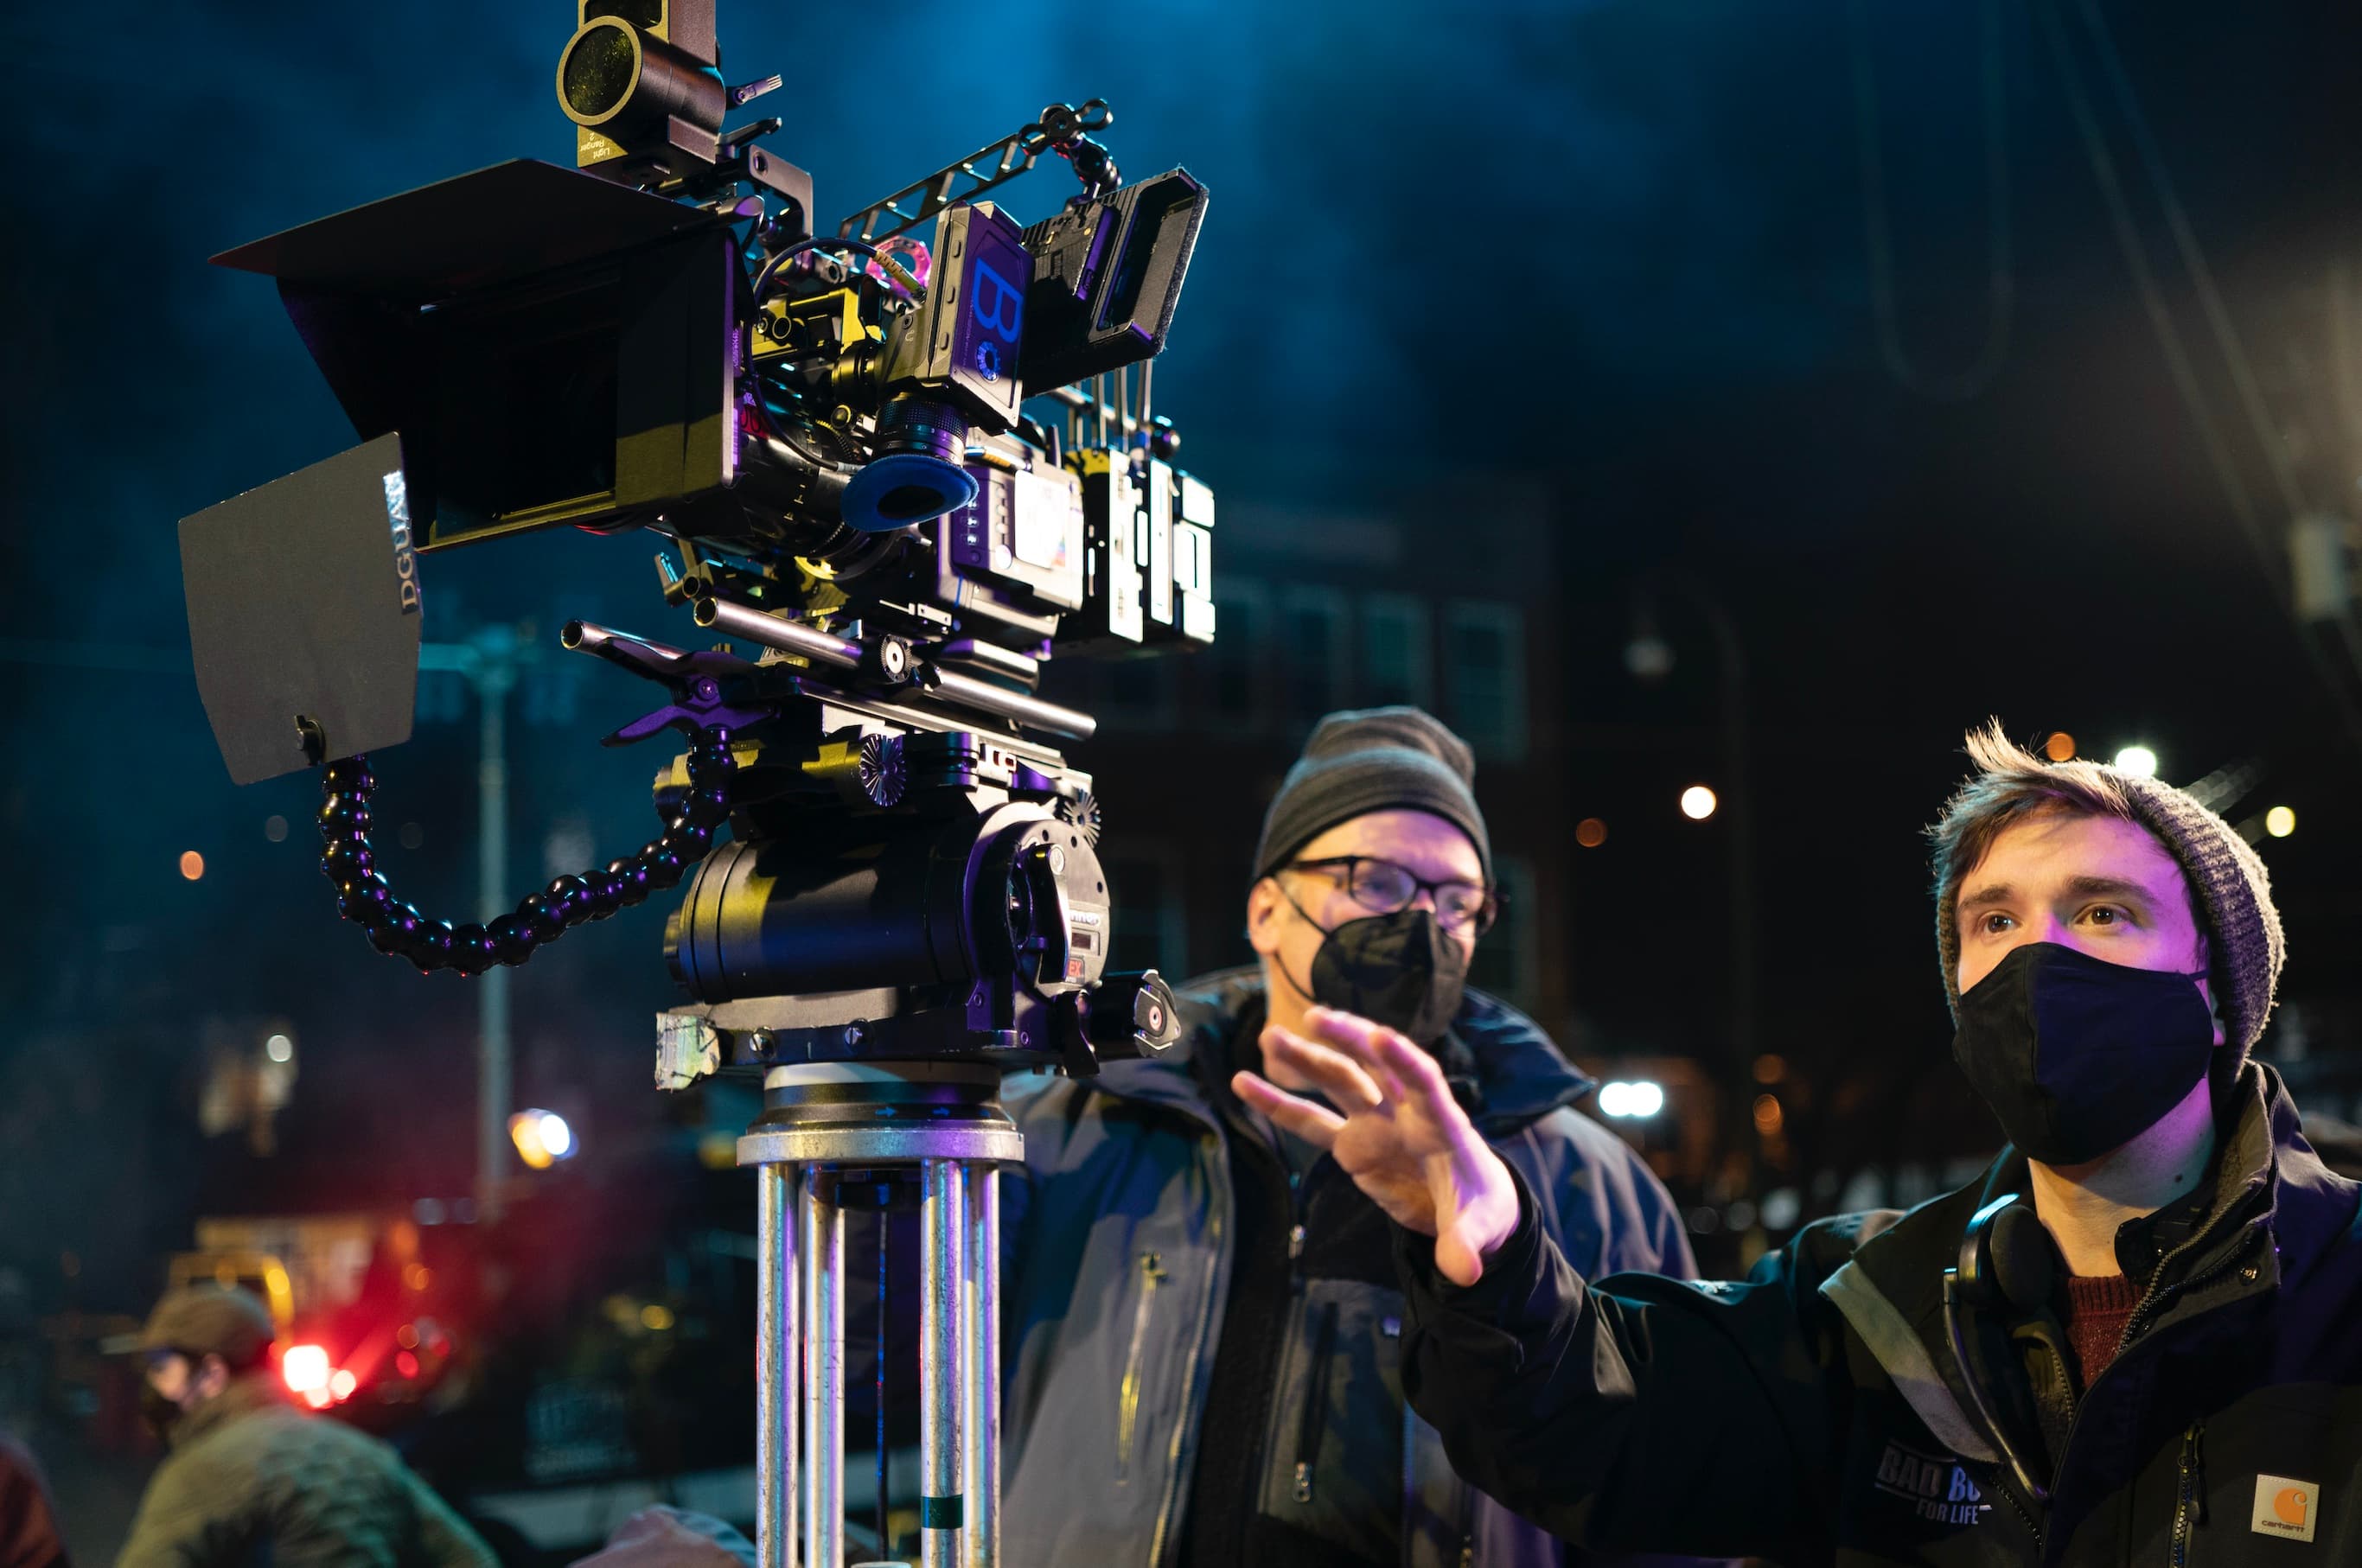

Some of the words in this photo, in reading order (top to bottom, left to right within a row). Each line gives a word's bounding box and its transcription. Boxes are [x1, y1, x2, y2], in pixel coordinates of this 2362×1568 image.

[589, 132, 595, 141] 2
[580, 139, 604, 151] Ranger
[593, 147, 610, 159] Light
[973, 258, 1024, 343] B
[1876, 1445, 1944, 1497] BAD
[1916, 1499, 1949, 1522] FOR
[1950, 1504, 1979, 1525] LIFE
[2261, 1520, 2305, 1533] carhartt
